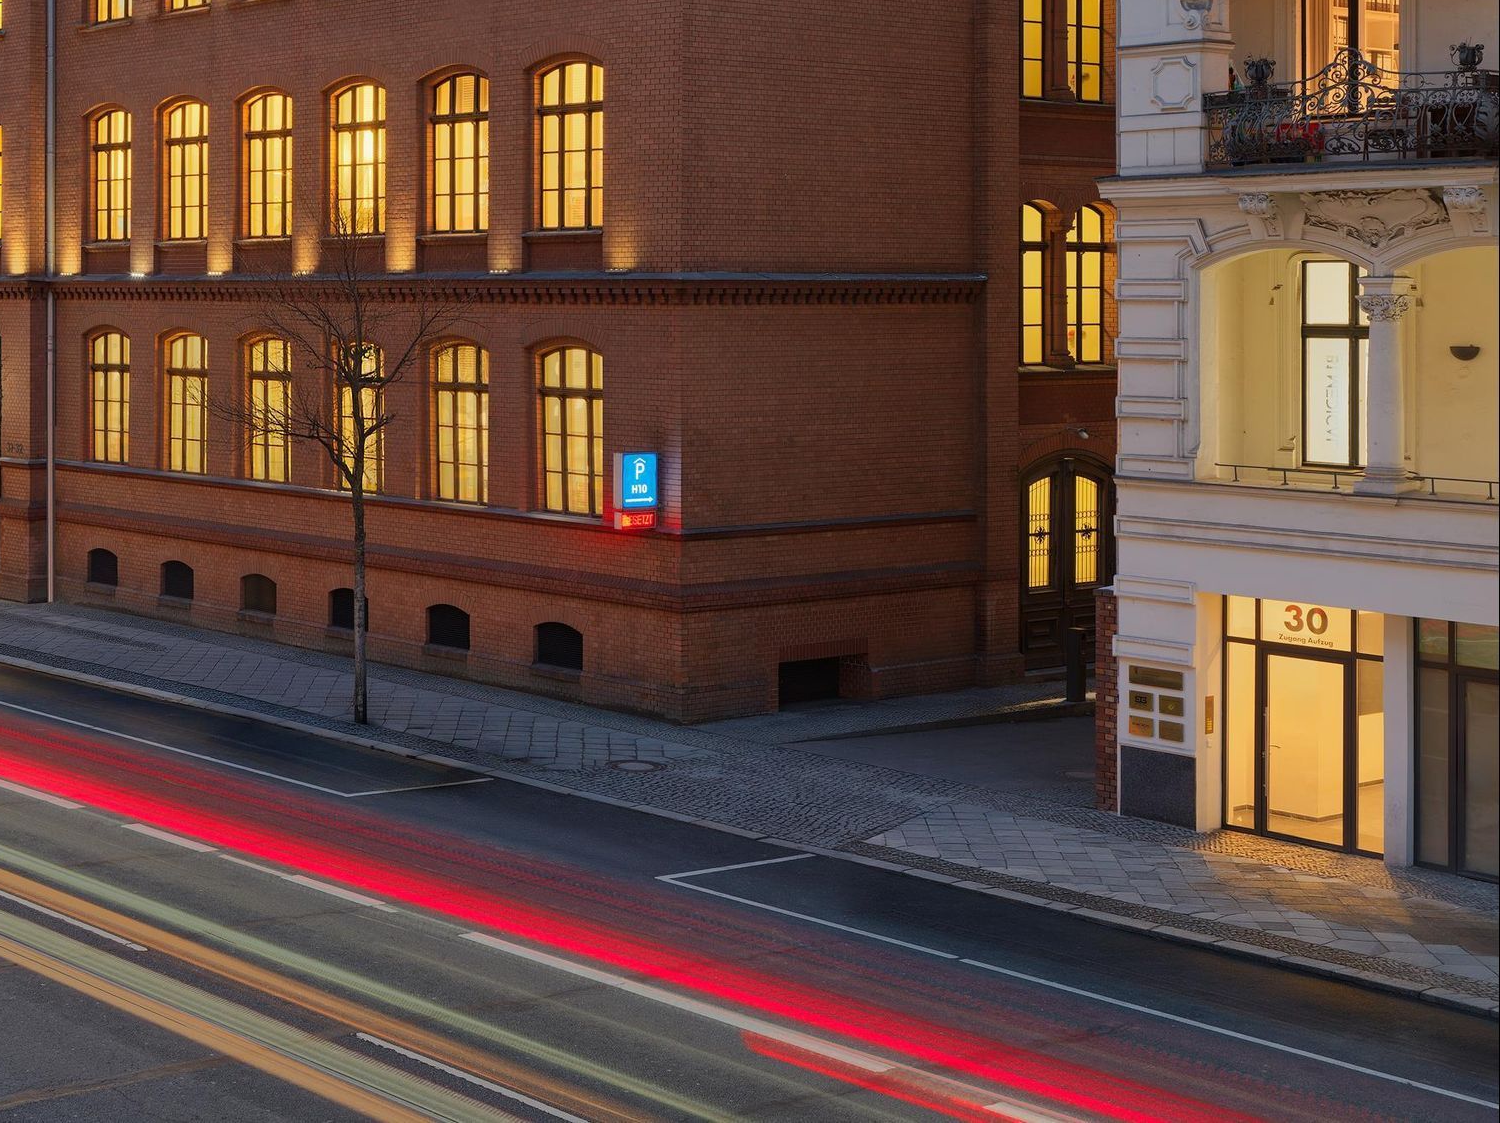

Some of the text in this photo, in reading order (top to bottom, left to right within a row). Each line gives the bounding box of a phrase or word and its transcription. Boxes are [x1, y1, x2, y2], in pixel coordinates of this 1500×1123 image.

[635, 462, 646, 480] P
[631, 484, 648, 494] H10
[1284, 604, 1328, 635] 30
[1278, 633, 1334, 648] Zugang Aufzug
